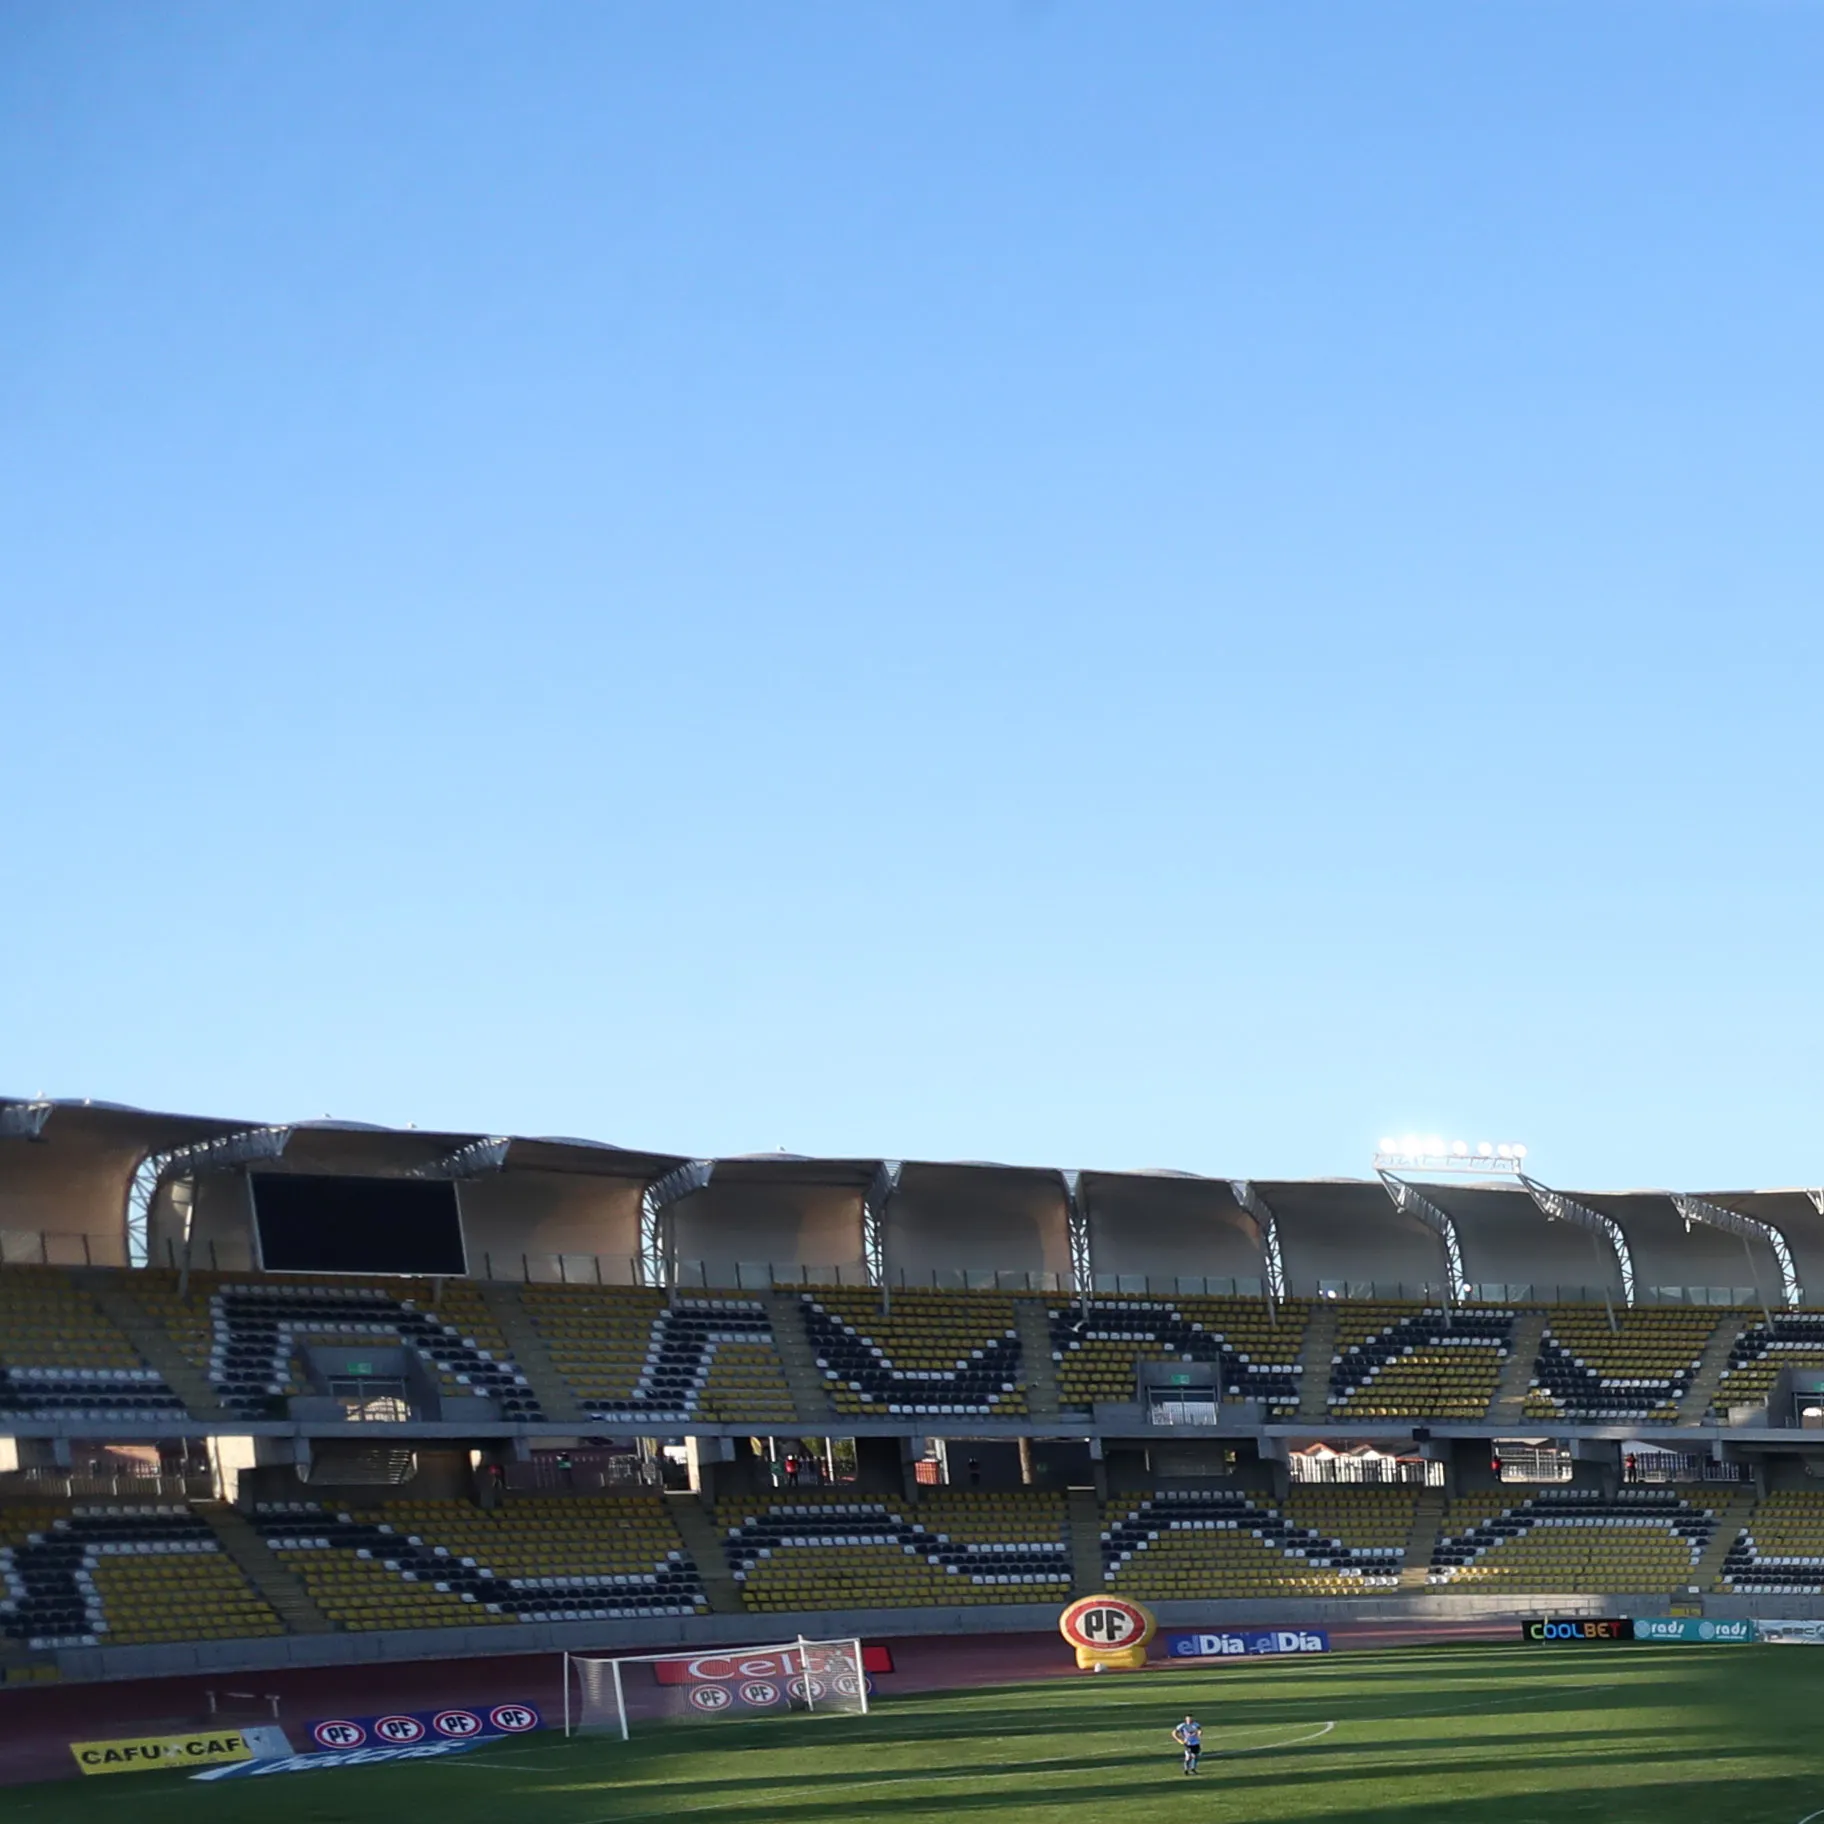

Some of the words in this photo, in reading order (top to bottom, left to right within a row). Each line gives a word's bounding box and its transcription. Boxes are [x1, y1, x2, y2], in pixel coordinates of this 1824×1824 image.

[1084, 1609, 1126, 1641] PF
[1530, 1622, 1620, 1639] COOLBET
[700, 1692, 722, 1706] PF
[748, 1686, 769, 1701] PF
[444, 1715, 469, 1731] PF
[501, 1711, 525, 1727] PF
[326, 1726, 352, 1742] PF
[389, 1721, 412, 1736] PF
[82, 1745, 160, 1765] CAFU
[186, 1737, 250, 1756] CAF
